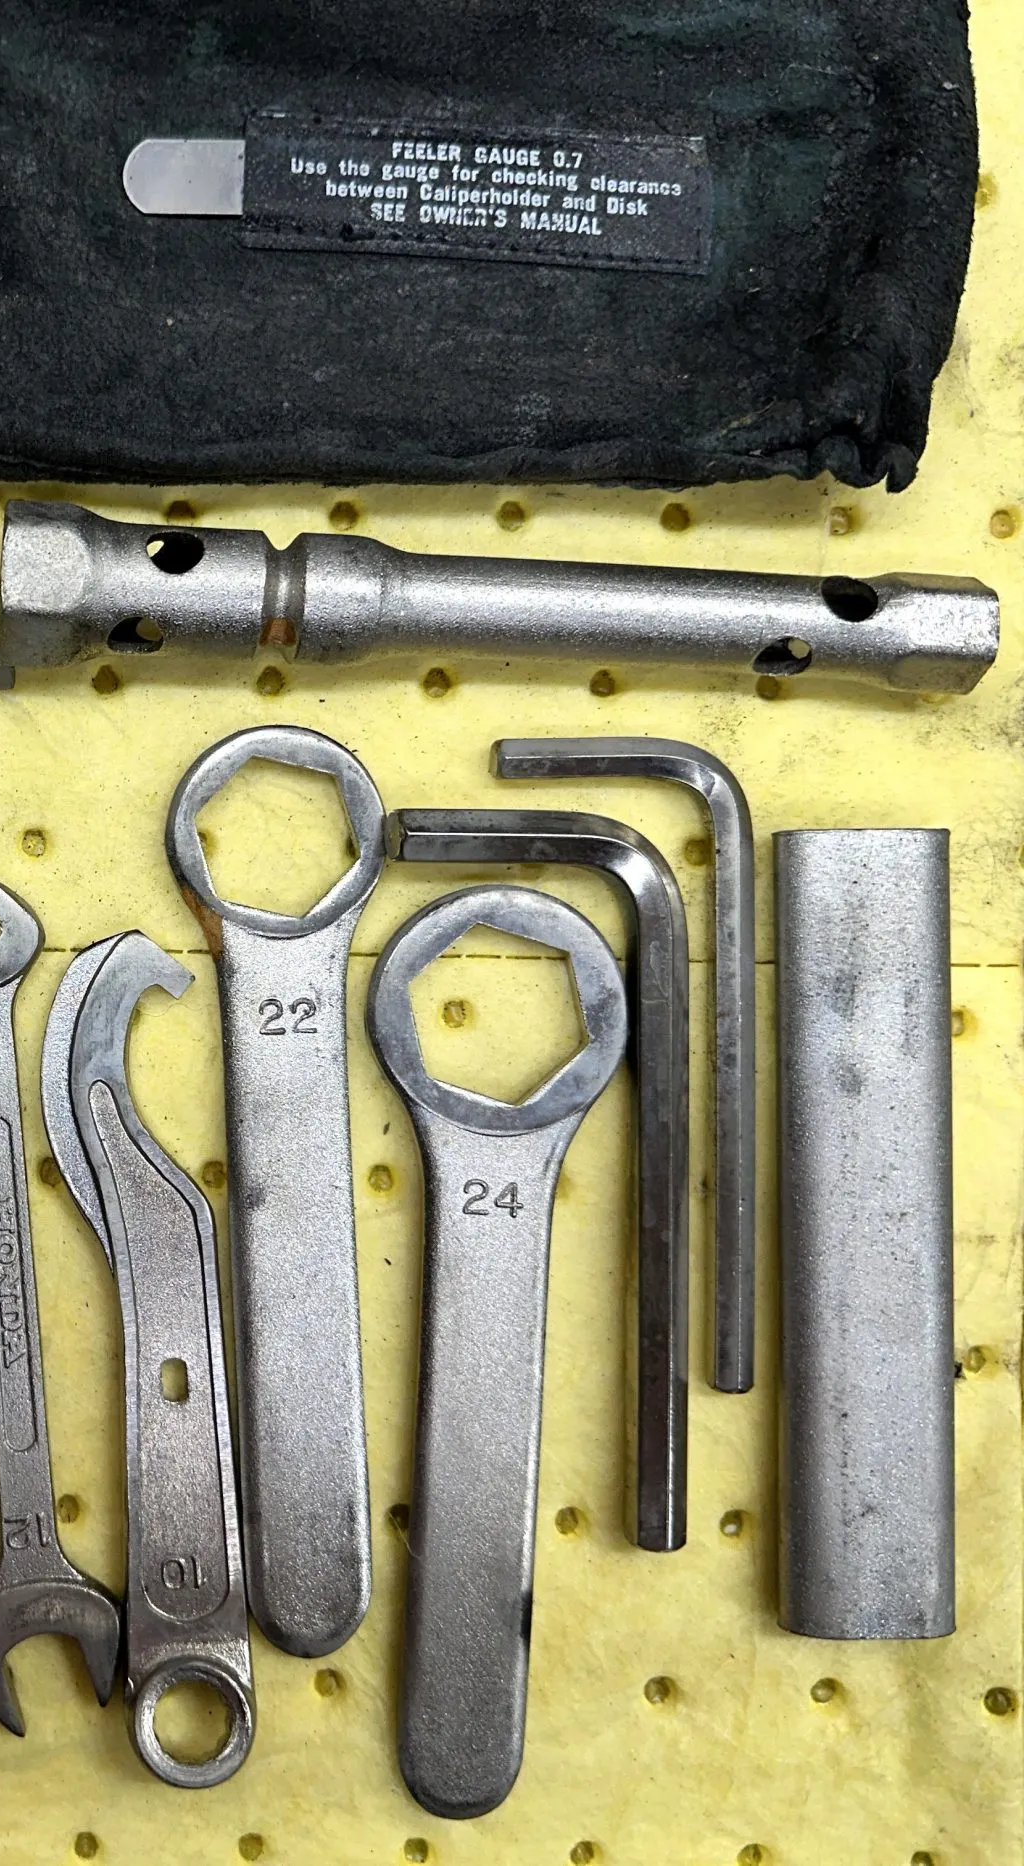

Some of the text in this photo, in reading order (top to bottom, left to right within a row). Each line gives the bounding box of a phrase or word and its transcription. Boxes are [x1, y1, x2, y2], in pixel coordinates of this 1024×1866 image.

[392, 141, 583, 169] FEELER GAUGE 0.7
[290, 157, 682, 197] Use the gauge for checking clearance
[326, 179, 649, 217] between Caliperholder and Disk
[370, 202, 603, 236] SEE OWNER'S MANUAL
[257, 997, 319, 1036] 22
[461, 1178, 524, 1220] 24
[4, 1511, 52, 1551] 12
[161, 1557, 208, 1592] 10
